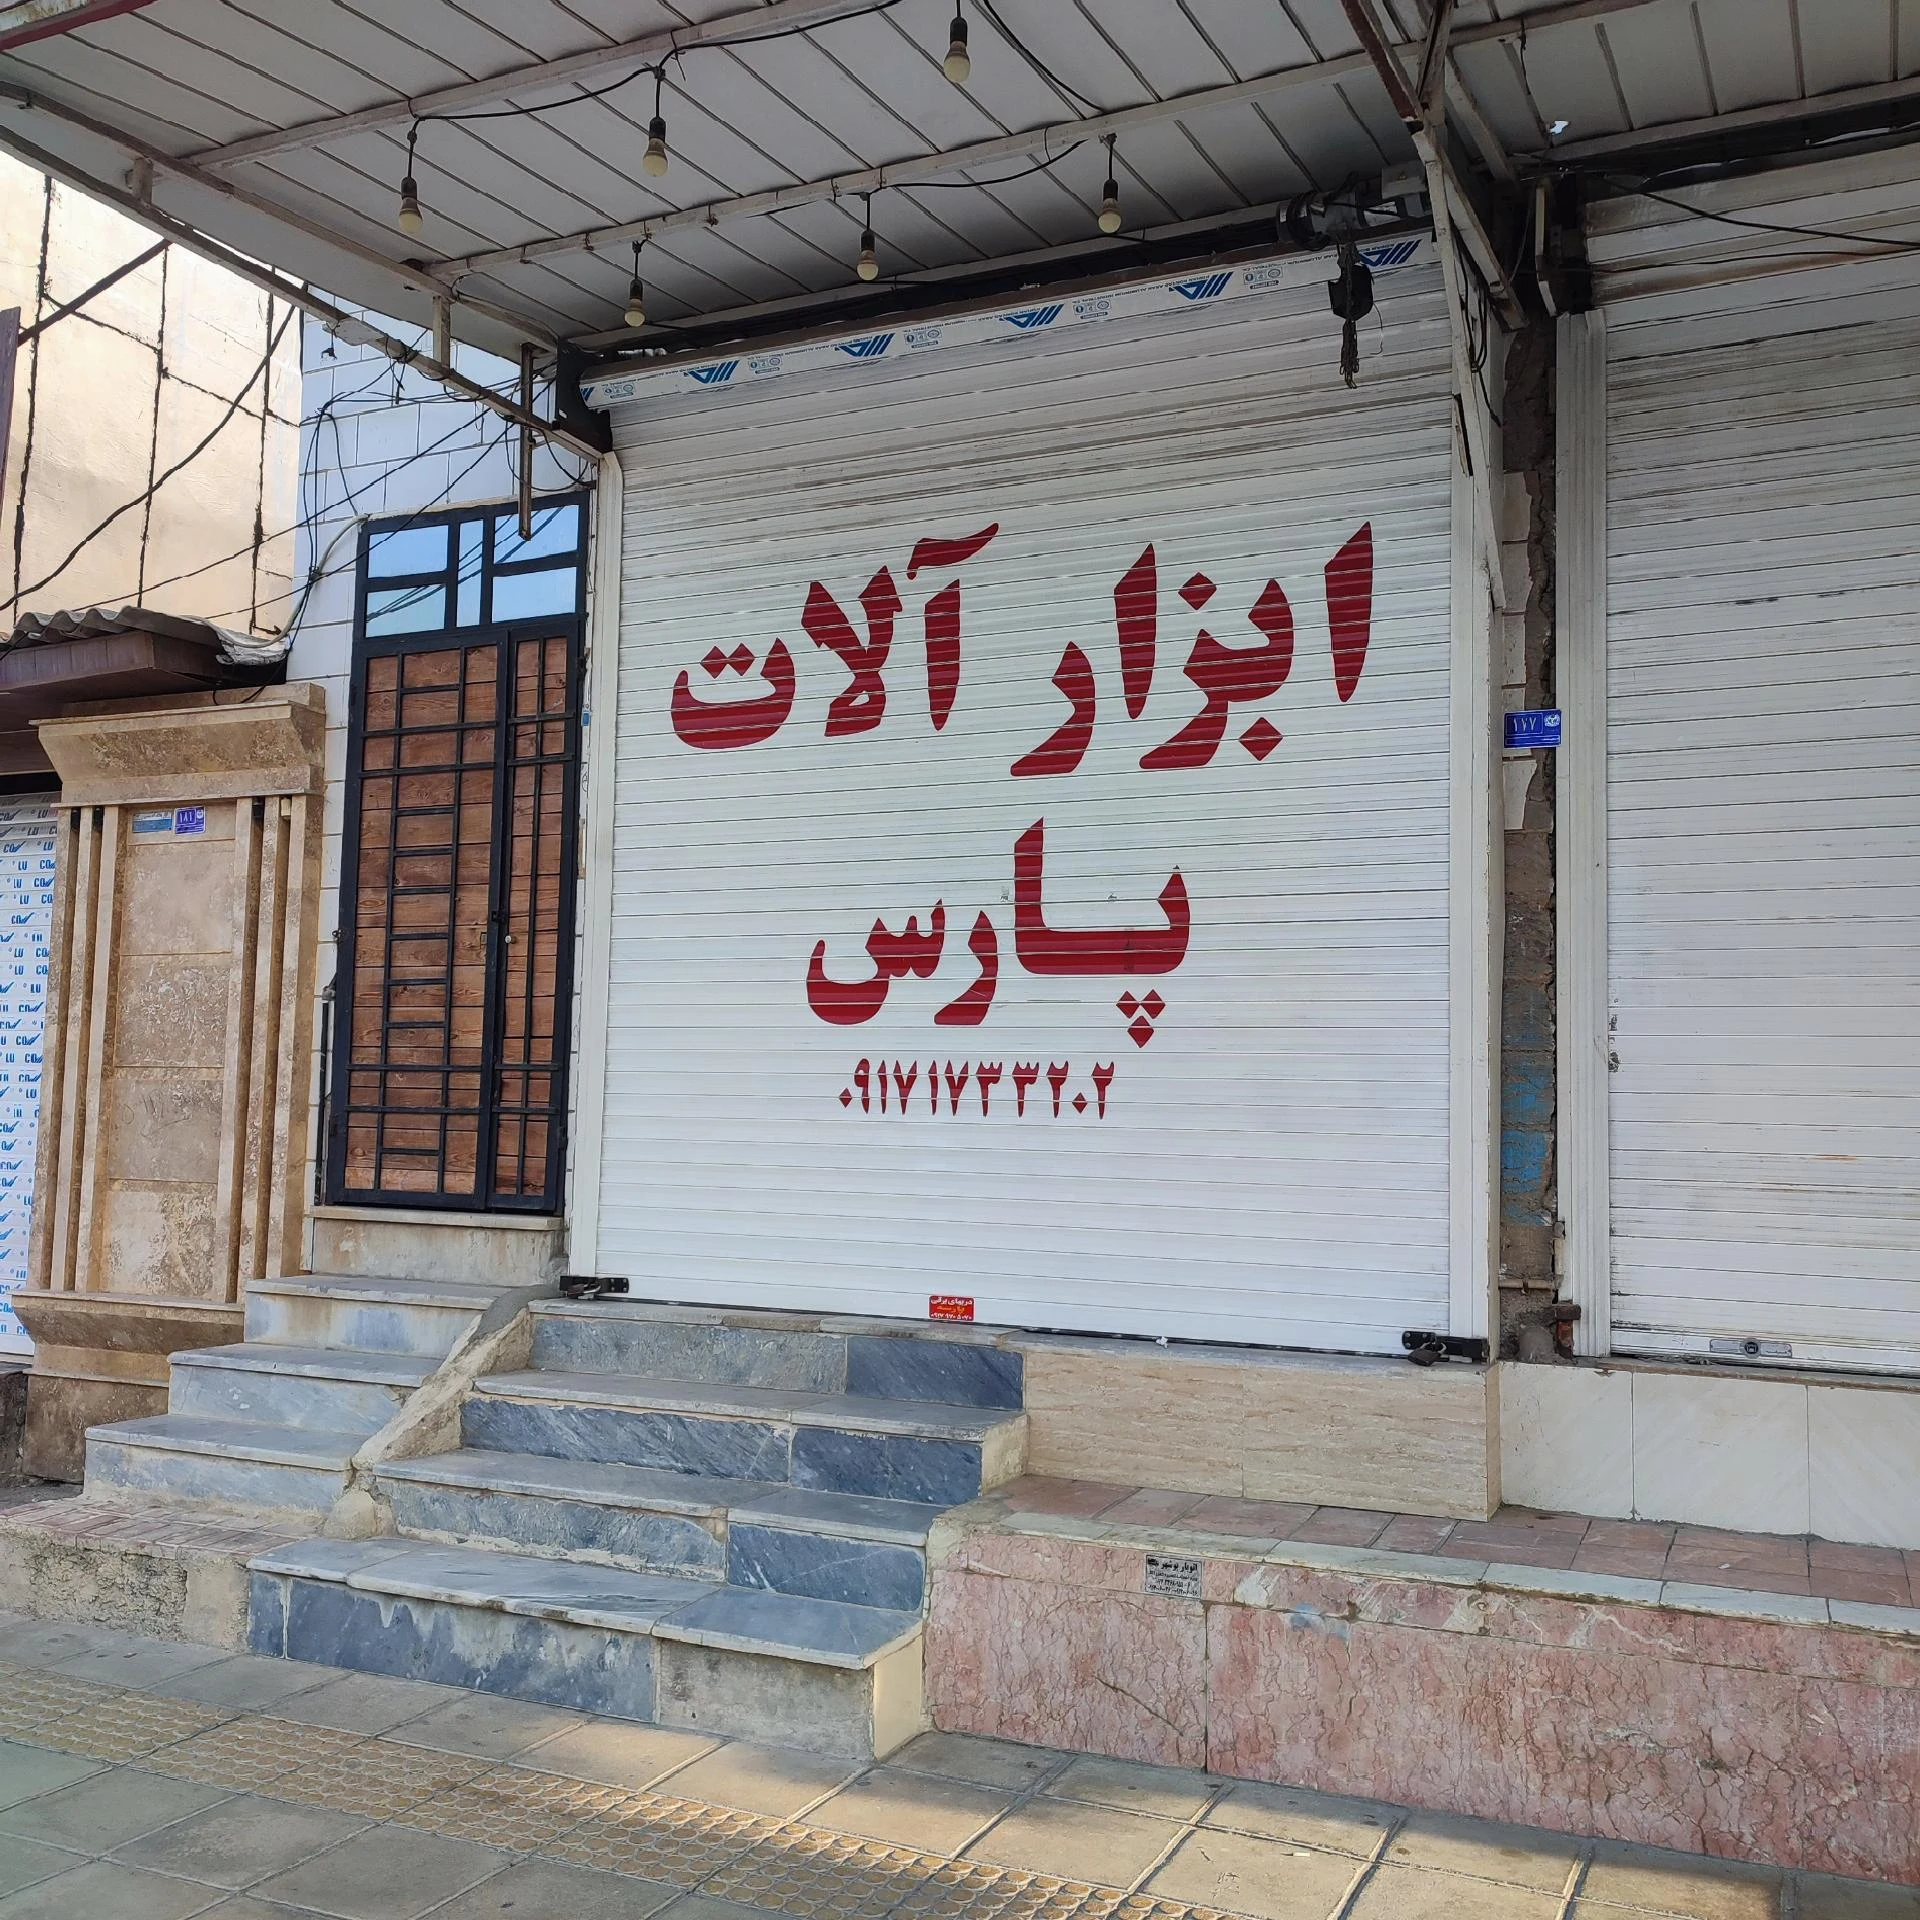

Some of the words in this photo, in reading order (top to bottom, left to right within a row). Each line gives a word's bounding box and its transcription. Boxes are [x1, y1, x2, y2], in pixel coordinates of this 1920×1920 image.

[671, 522, 999, 749] آلات
[1010, 521, 1374, 777] ابزار
[806, 816, 1190, 1048] پارس
[838, 1057, 1115, 1120] ۰۹۱۷۱۷۳۳۲۰۲
